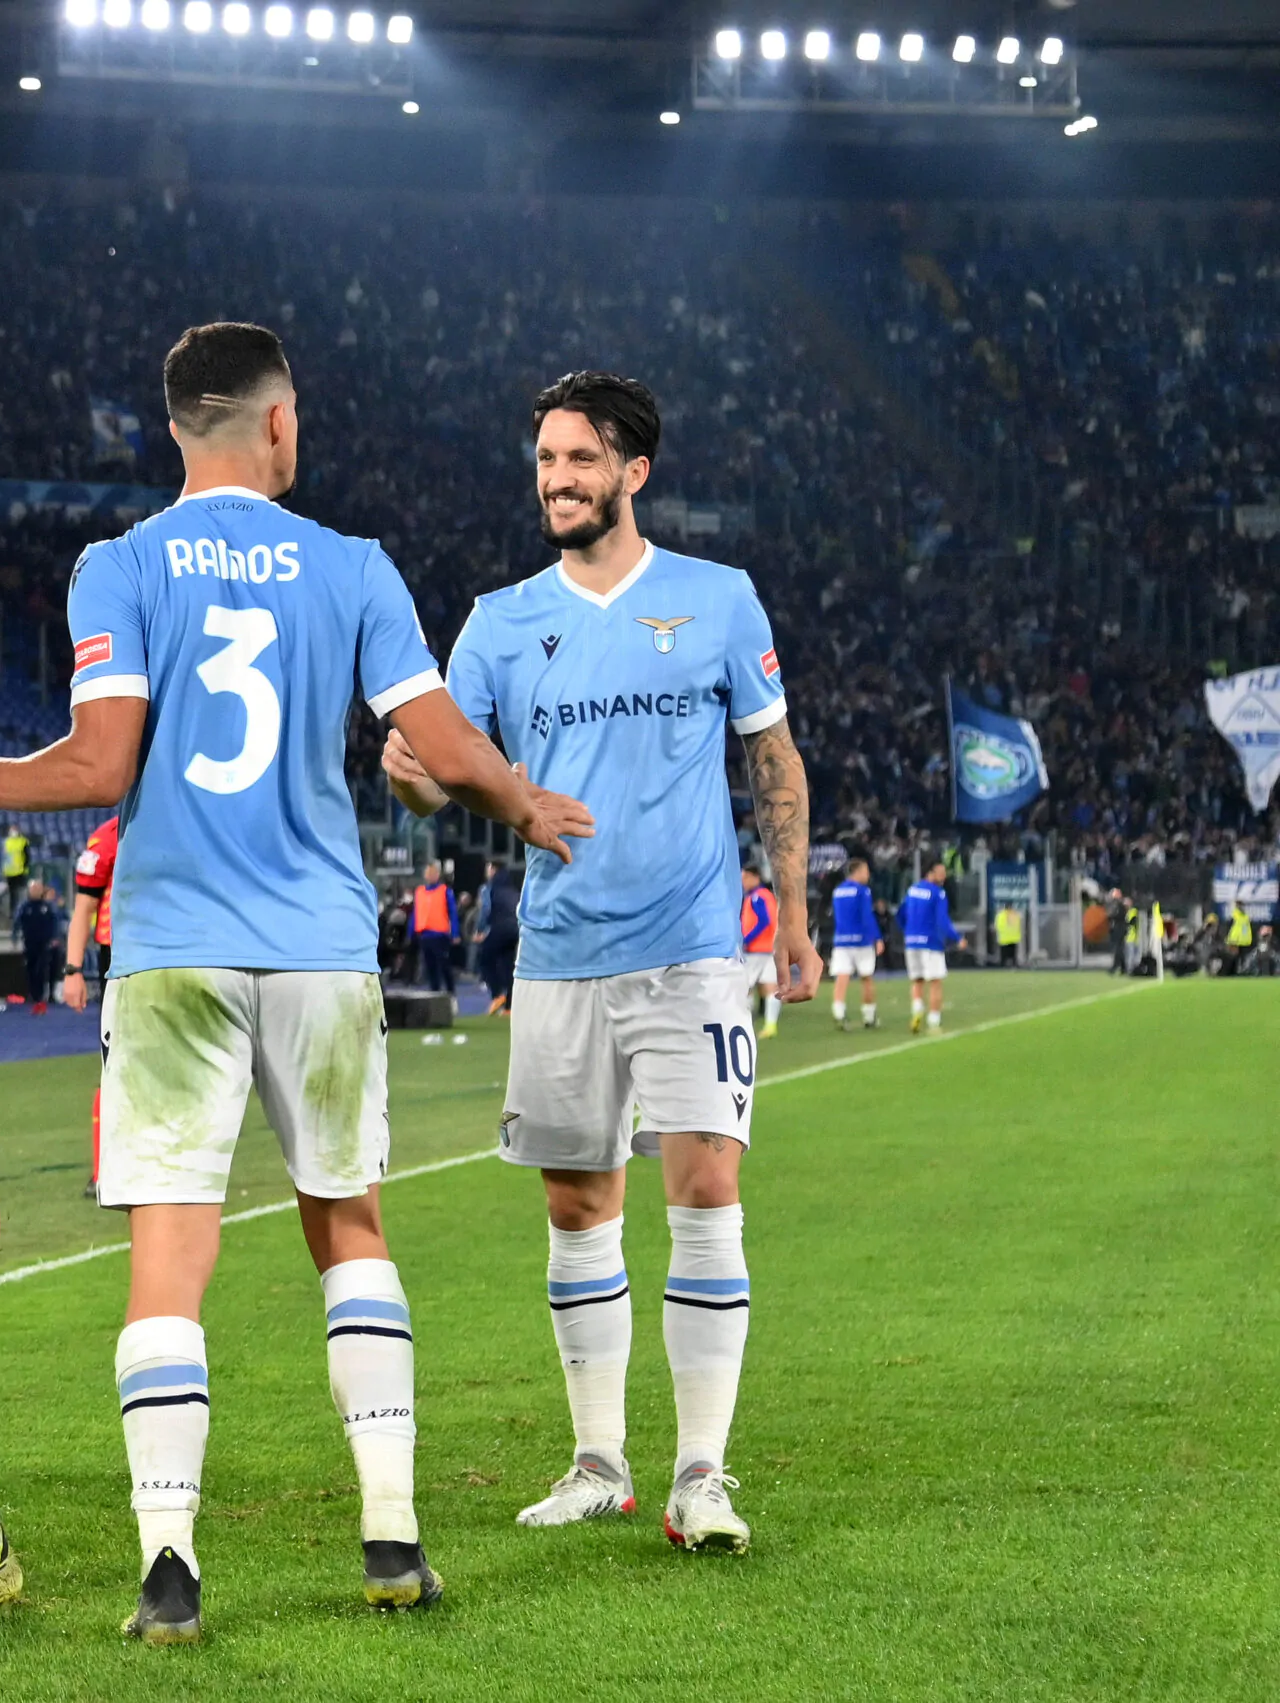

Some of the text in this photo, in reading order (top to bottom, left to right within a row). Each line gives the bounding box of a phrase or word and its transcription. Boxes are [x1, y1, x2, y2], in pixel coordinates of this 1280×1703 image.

[165, 538, 301, 584] RAMOS
[184, 604, 280, 795] 3
[558, 692, 690, 727] BINANCE
[703, 1023, 754, 1087] 10
